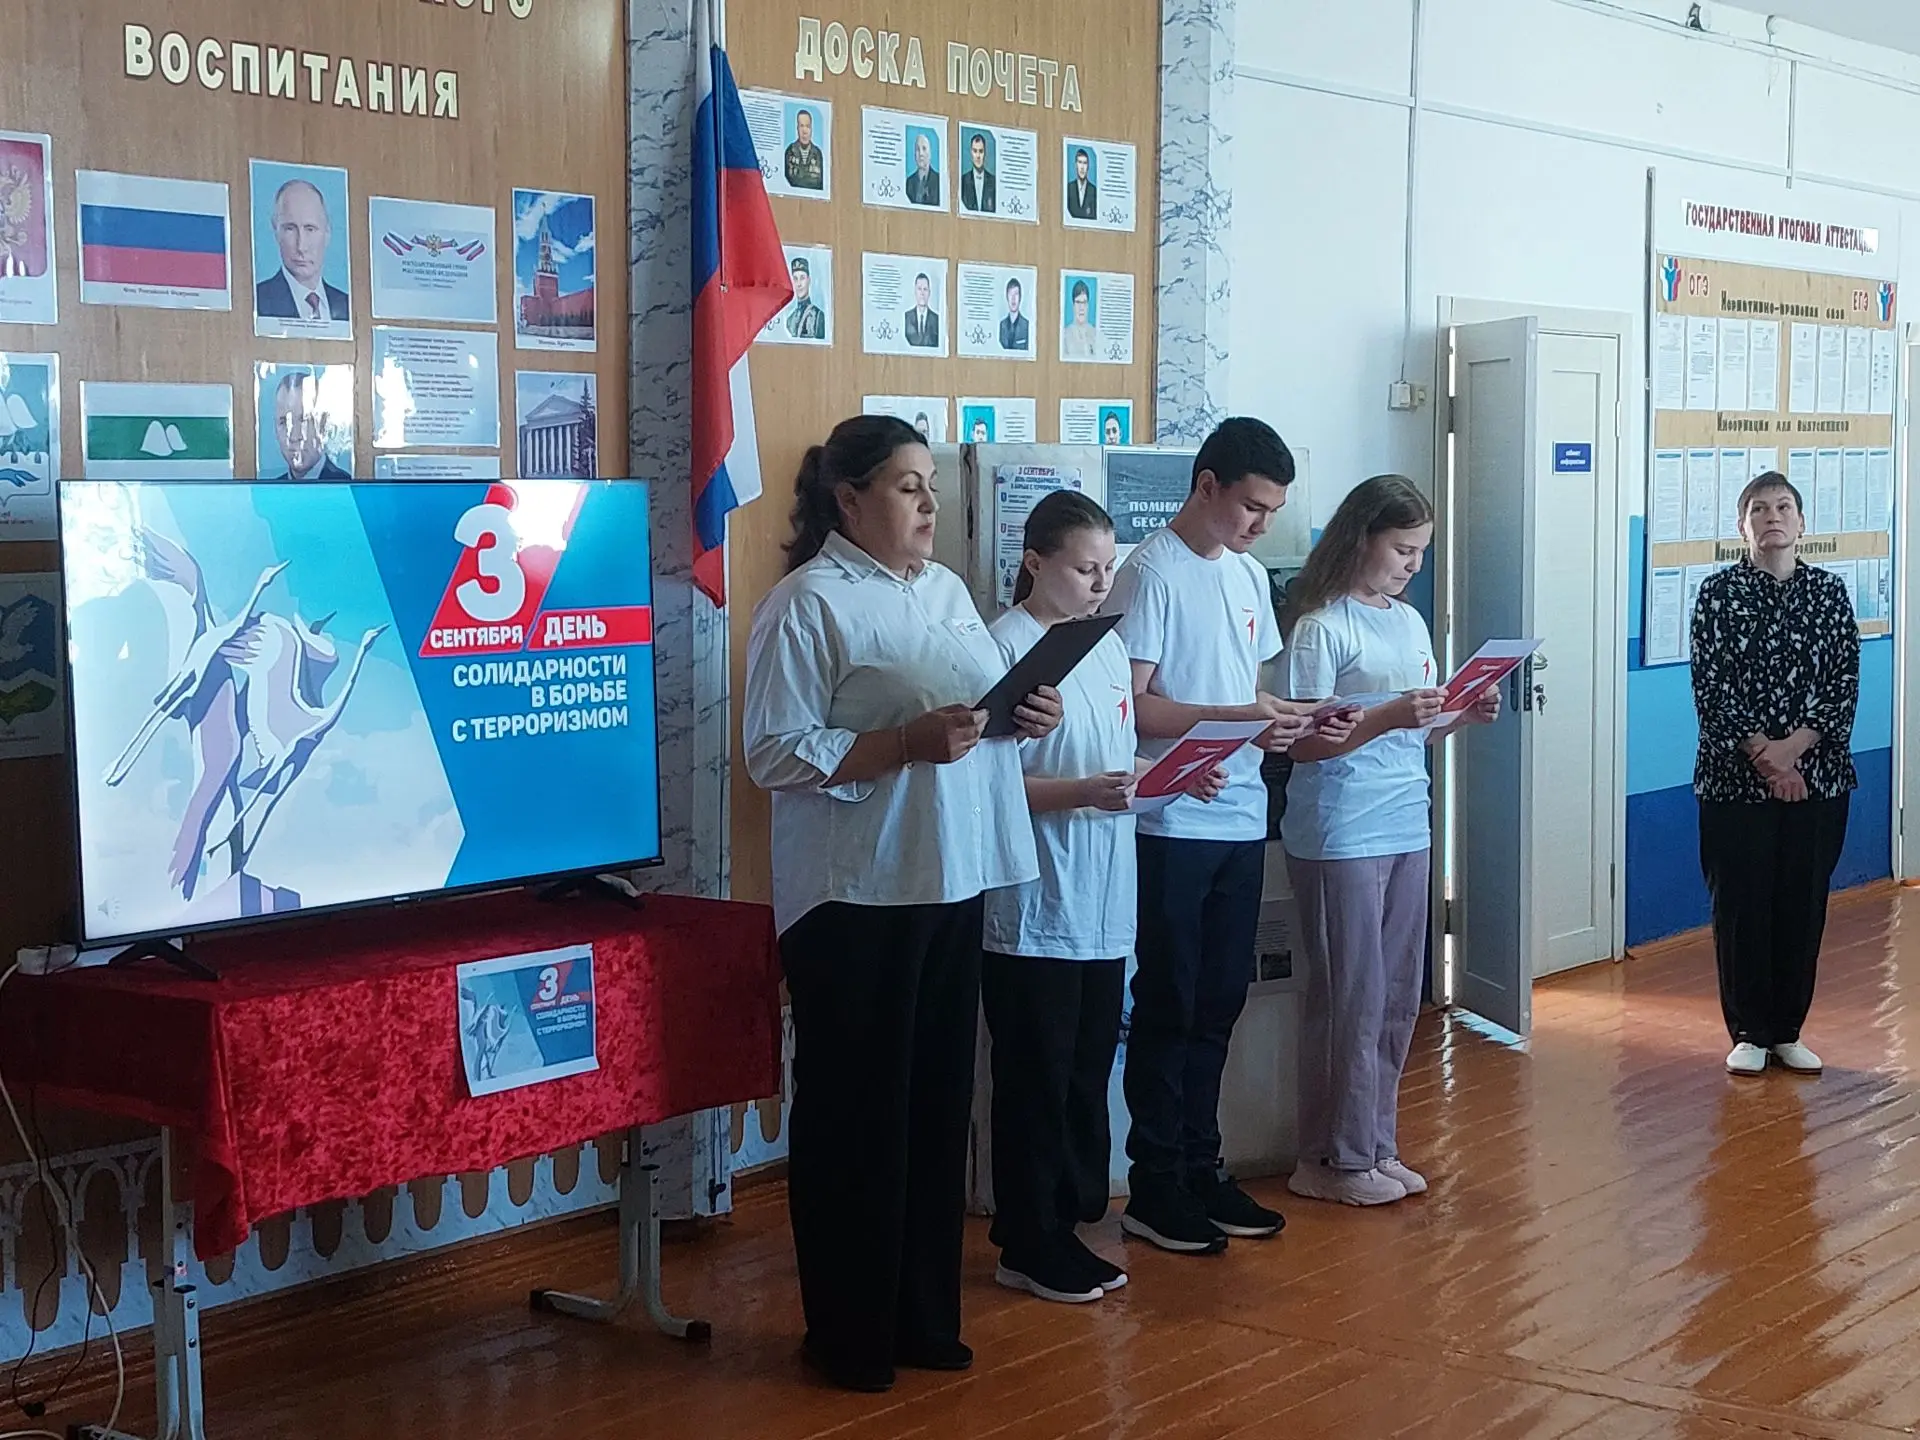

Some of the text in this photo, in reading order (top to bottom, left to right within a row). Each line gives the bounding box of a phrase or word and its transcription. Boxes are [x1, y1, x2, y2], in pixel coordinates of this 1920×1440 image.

[123, 24, 459, 119] ВОСПИТАНИЯ
[795, 17, 1082, 112] ДОСКА ПОЧЕТА
[1685, 202, 1874, 256] ГОСУДАРСТВЕННАЯ ИТОГОВАЯ АТТЕСТАЦ
[1689, 274, 1709, 296] ОГЭ
[1853, 290, 1869, 311] ЕГЭ
[1128, 501, 1184, 512] ПОМНИ
[454, 503, 526, 622] 3
[430, 625, 523, 649] СЕНТЯБРЯ
[543, 615, 607, 647] ДЕНЬ
[453, 654, 626, 687] СОЛИДАРНОСТИ
[531, 680, 627, 708] В БОРЬБЕ
[452, 706, 628, 742] С ТЕРРОРИЗМОМ
[538, 967, 558, 1001] 3
